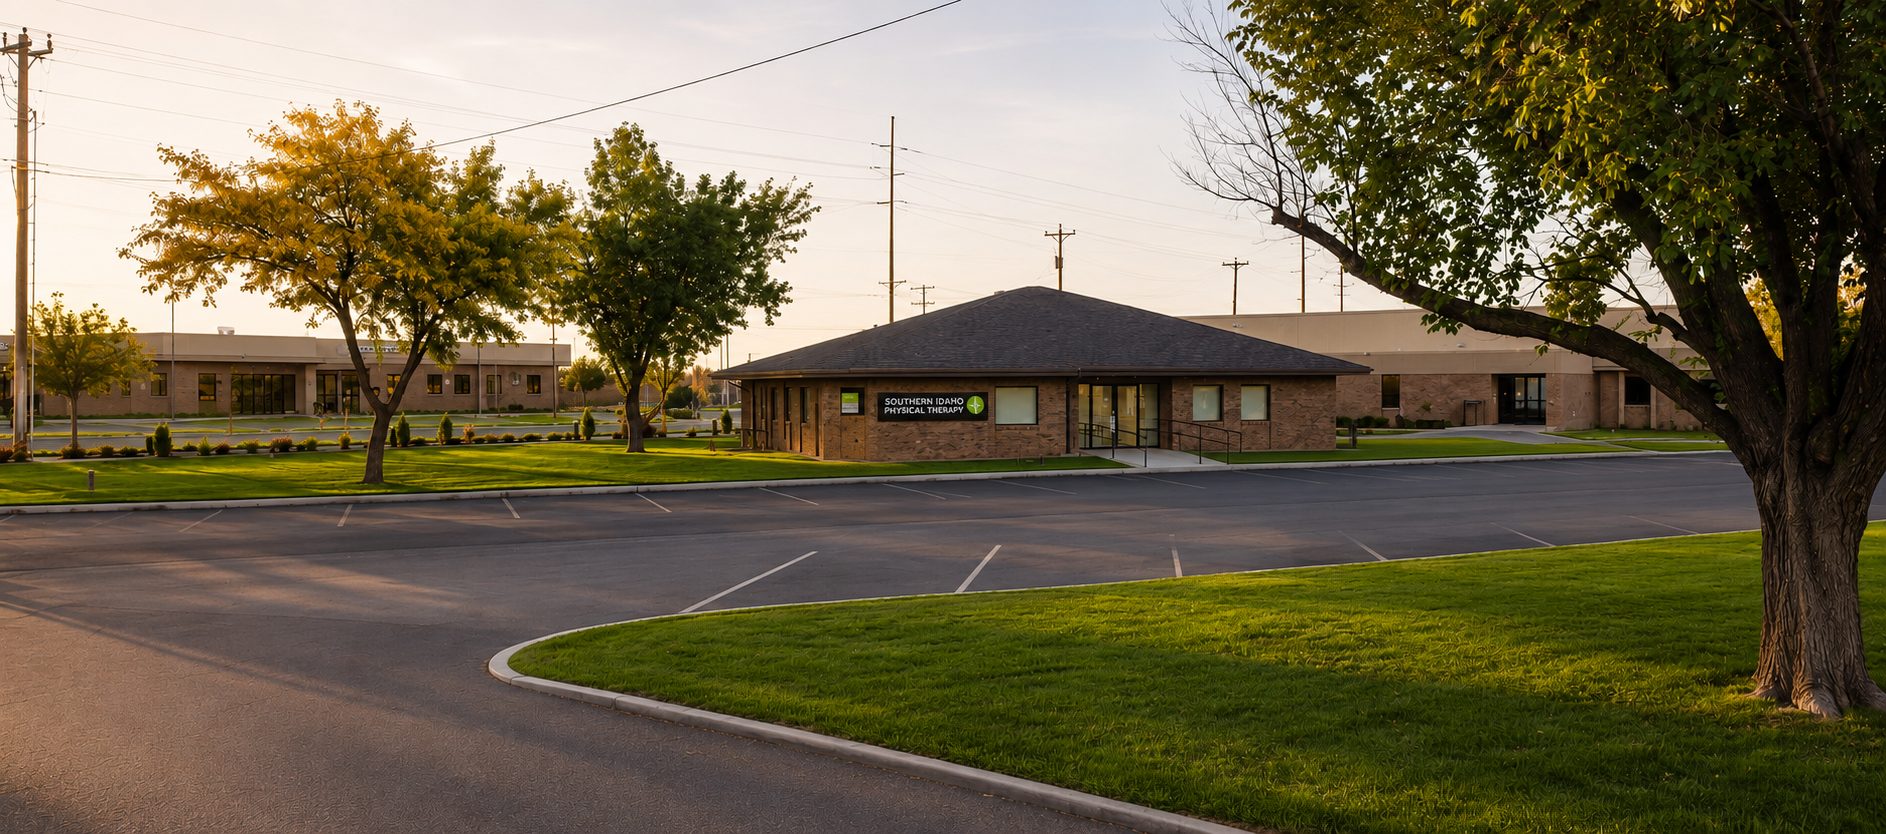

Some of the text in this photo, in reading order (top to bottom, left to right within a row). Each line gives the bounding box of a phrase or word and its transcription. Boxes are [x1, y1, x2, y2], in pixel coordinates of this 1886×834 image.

[884, 397, 964, 406] SOUTHERN IDAHO
[884, 406, 964, 414] PHYSICAL THERAPY
